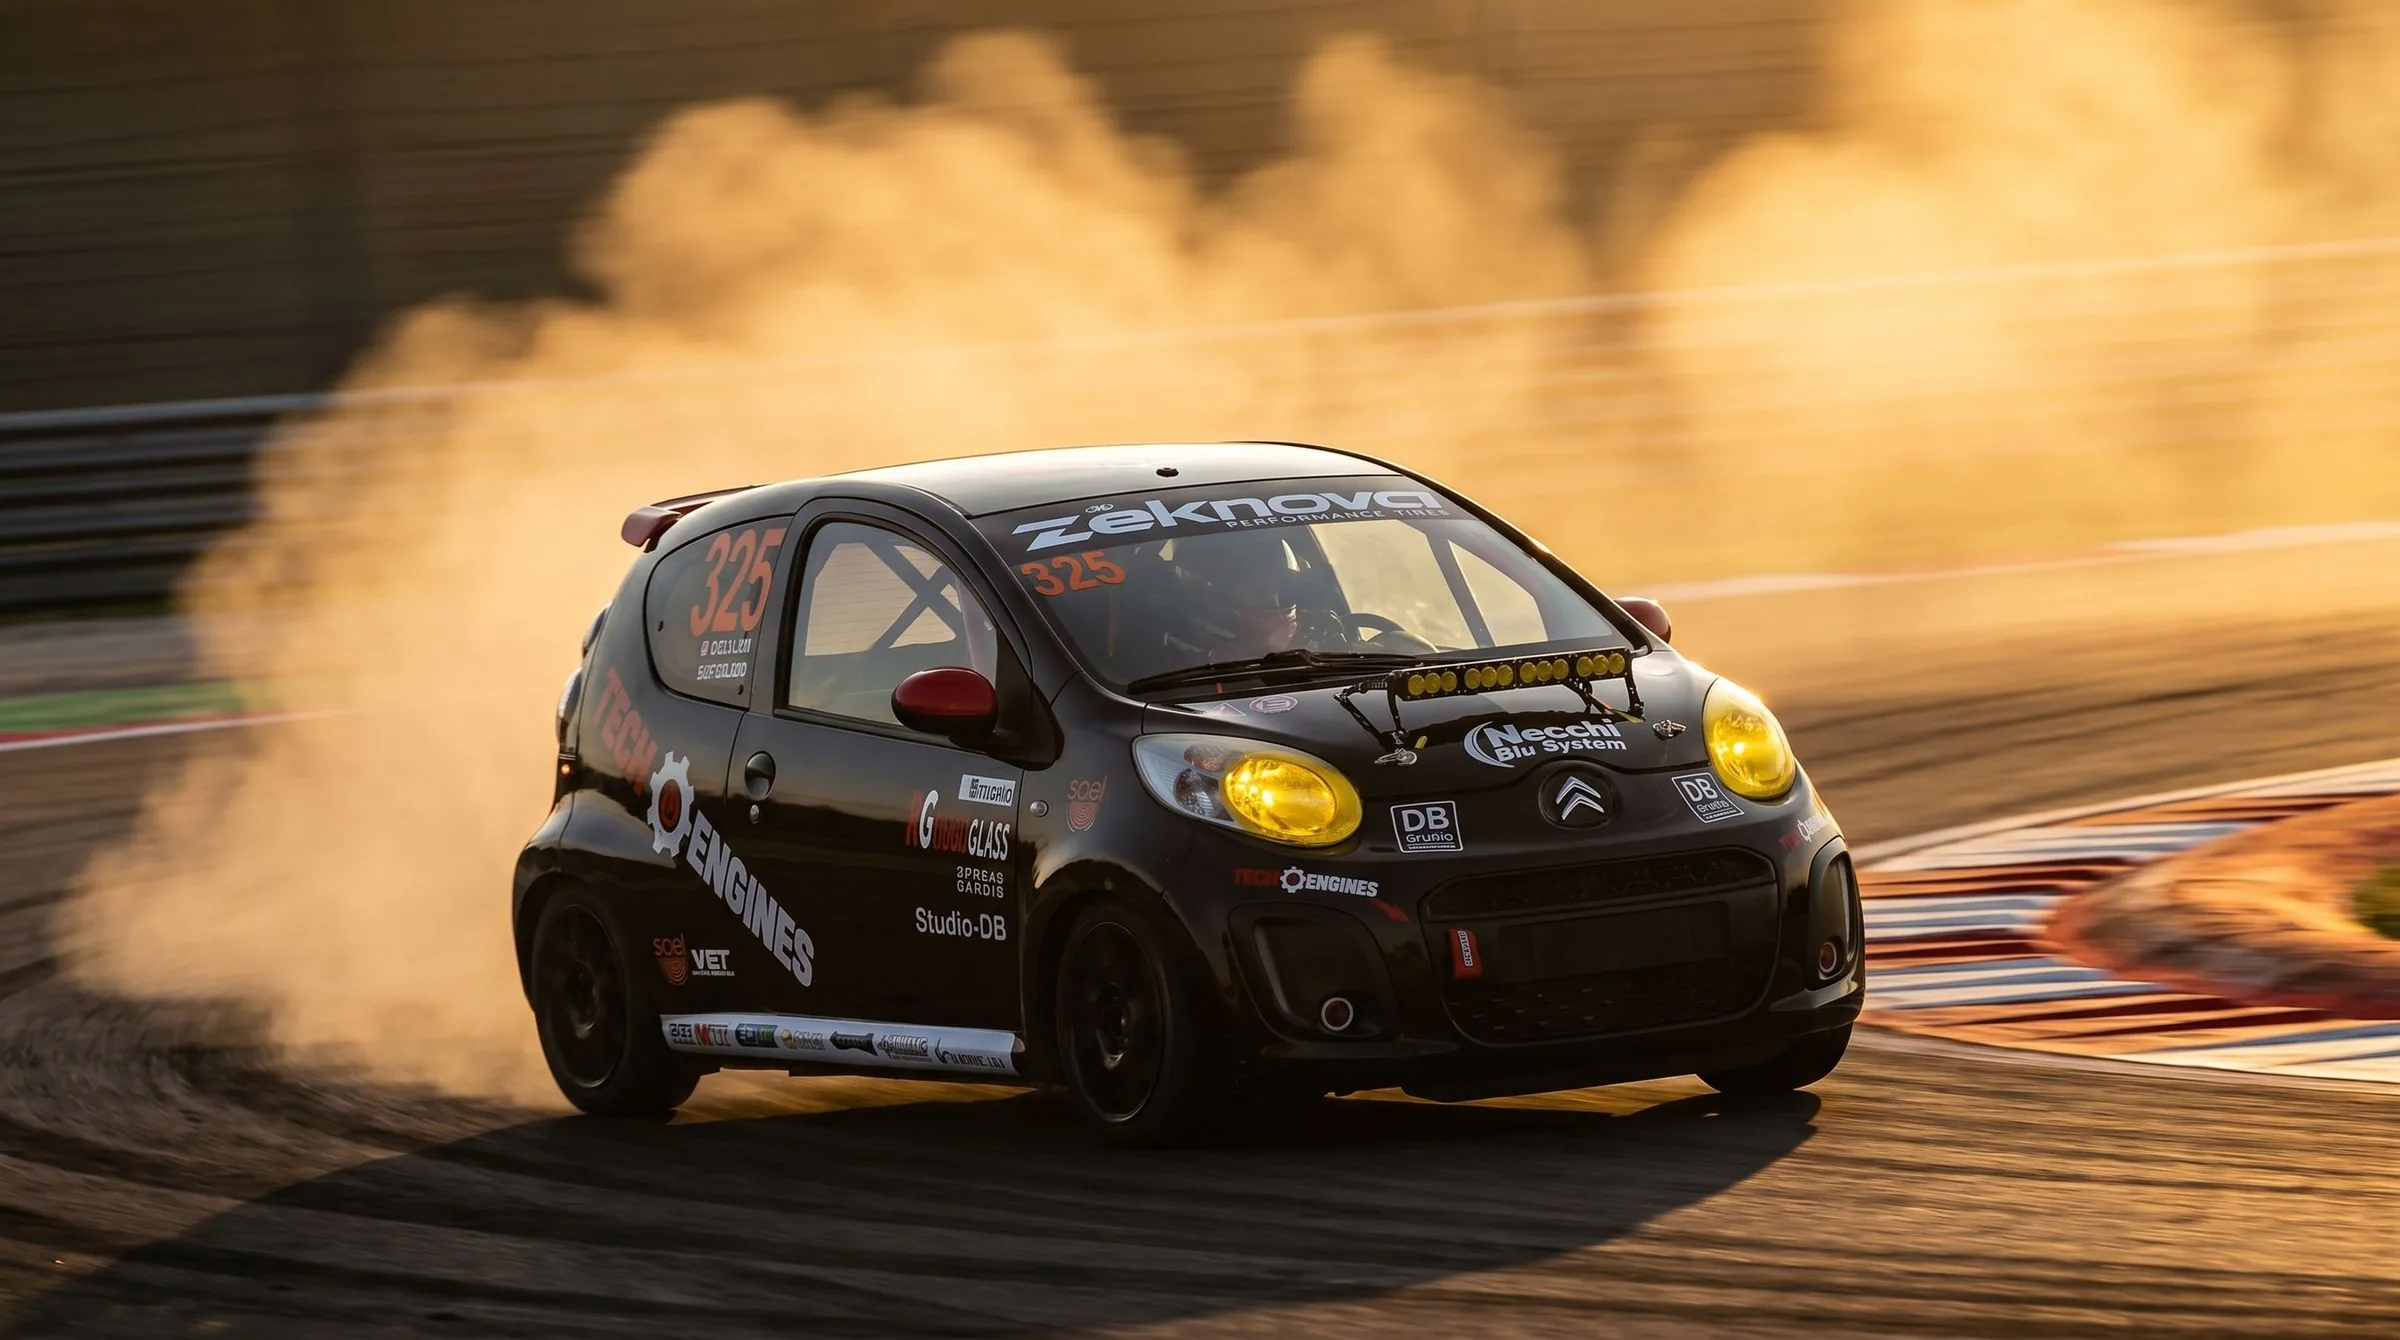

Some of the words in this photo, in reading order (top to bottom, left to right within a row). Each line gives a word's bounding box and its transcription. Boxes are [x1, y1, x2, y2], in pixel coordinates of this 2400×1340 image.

[1226, 509, 1385, 529] PERFORMANCE
[1392, 508, 1450, 517] TIRES
[690, 528, 788, 636] 325
[1020, 550, 1128, 596] 325
[1483, 718, 1622, 748] Necchi
[1494, 745, 1537, 763] Blu
[1543, 738, 1627, 754] System
[1681, 778, 1718, 802] DB
[593, 666, 658, 797] TECH
[686, 810, 815, 987] ENGINES
[1401, 806, 1450, 832] DB
[967, 818, 1010, 861] GLASS
[956, 879, 1004, 899] GARDIS
[1305, 873, 1379, 897] ENGINES
[916, 907, 1007, 941] Studio-DB
[691, 949, 730, 970] VET
